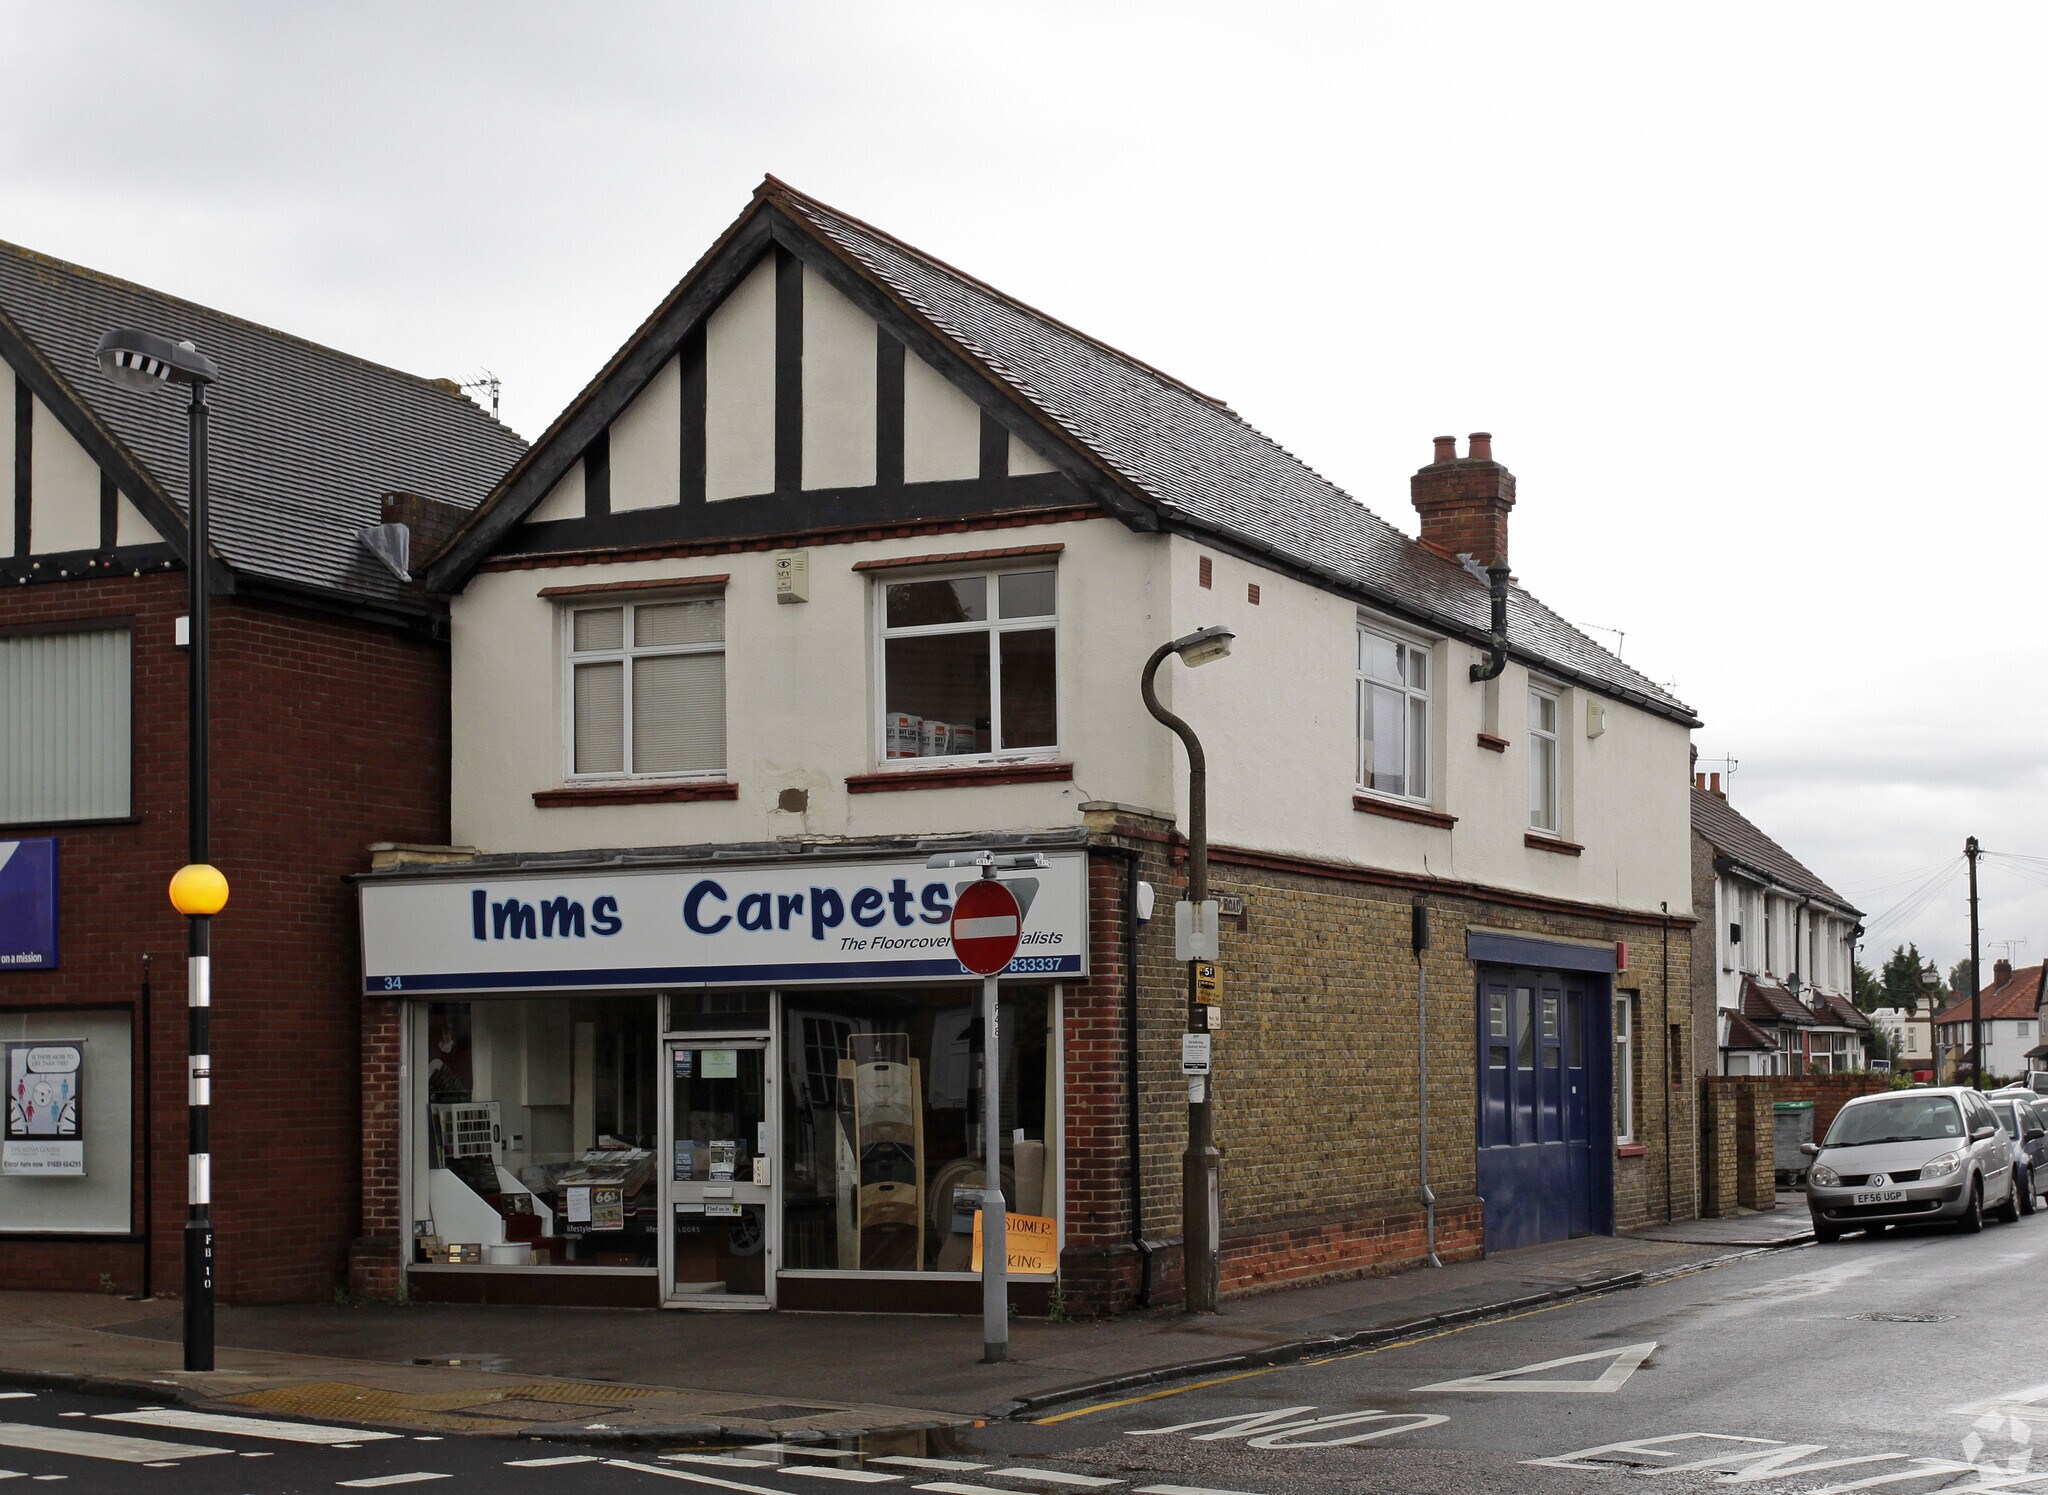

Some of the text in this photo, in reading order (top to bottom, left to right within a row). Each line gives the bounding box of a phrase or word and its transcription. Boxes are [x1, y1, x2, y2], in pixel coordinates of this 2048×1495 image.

[471, 879, 952, 941] Imms Carpets
[841, 937, 867, 950] The
[870, 936, 951, 950] Floorcover
[1, 951, 42, 964] on a mission
[1009, 957, 1063, 972] 833337
[384, 976, 402, 990] 34
[1858, 1191, 1902, 1203] EF56 UGP
[566, 1224, 592, 1234] lifestyle
